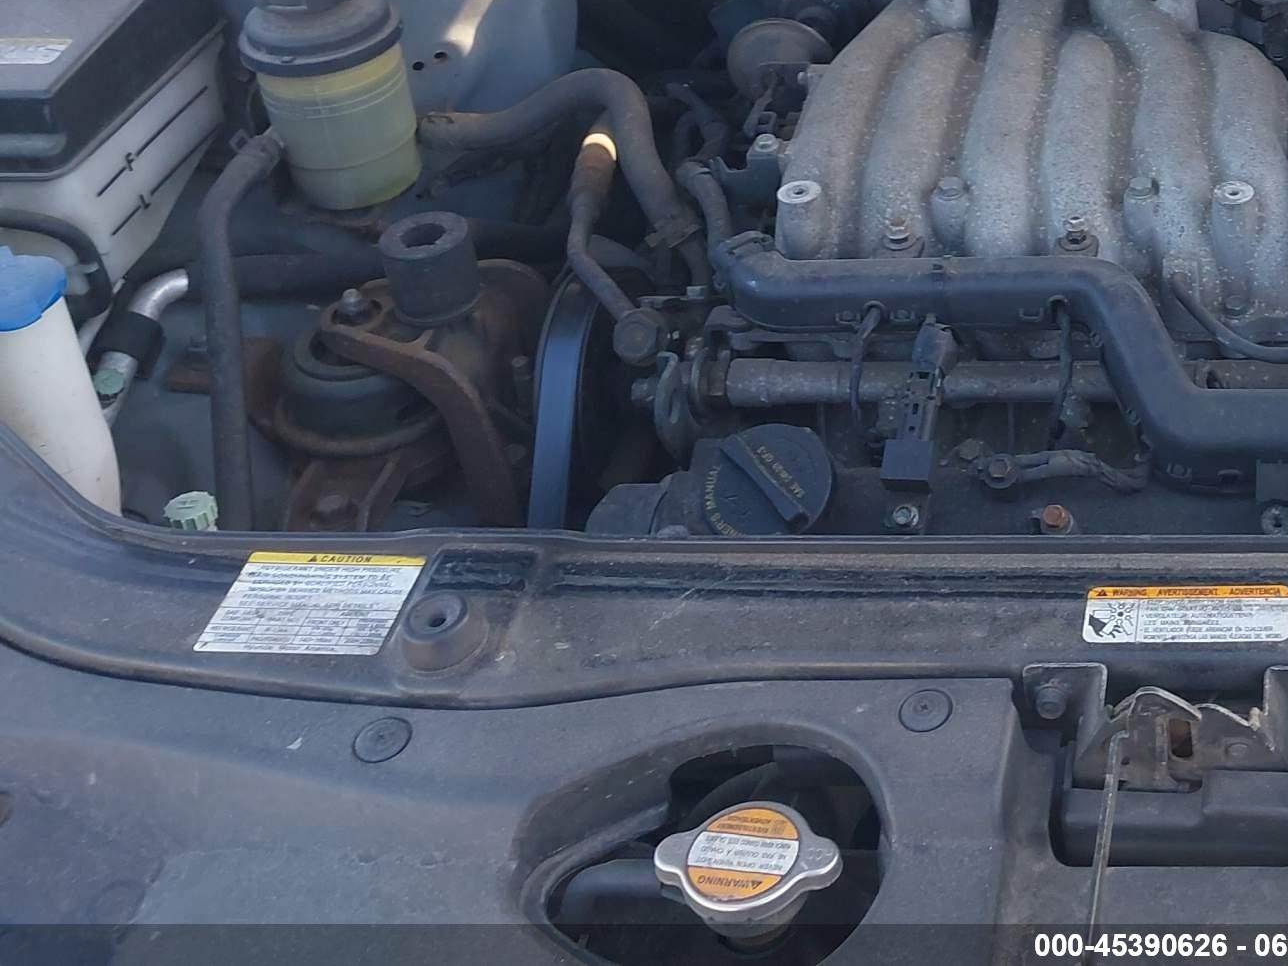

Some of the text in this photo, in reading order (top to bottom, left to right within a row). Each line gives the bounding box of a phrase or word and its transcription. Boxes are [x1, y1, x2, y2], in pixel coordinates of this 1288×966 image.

[125, 152, 135, 172] F
[140, 194, 152, 210] L
[704, 466, 720, 510] MANUAL
[319, 555, 373, 563] CAUTION
[1112, 589, 1147, 597] WARNING
[697, 874, 750, 888] WARNING
